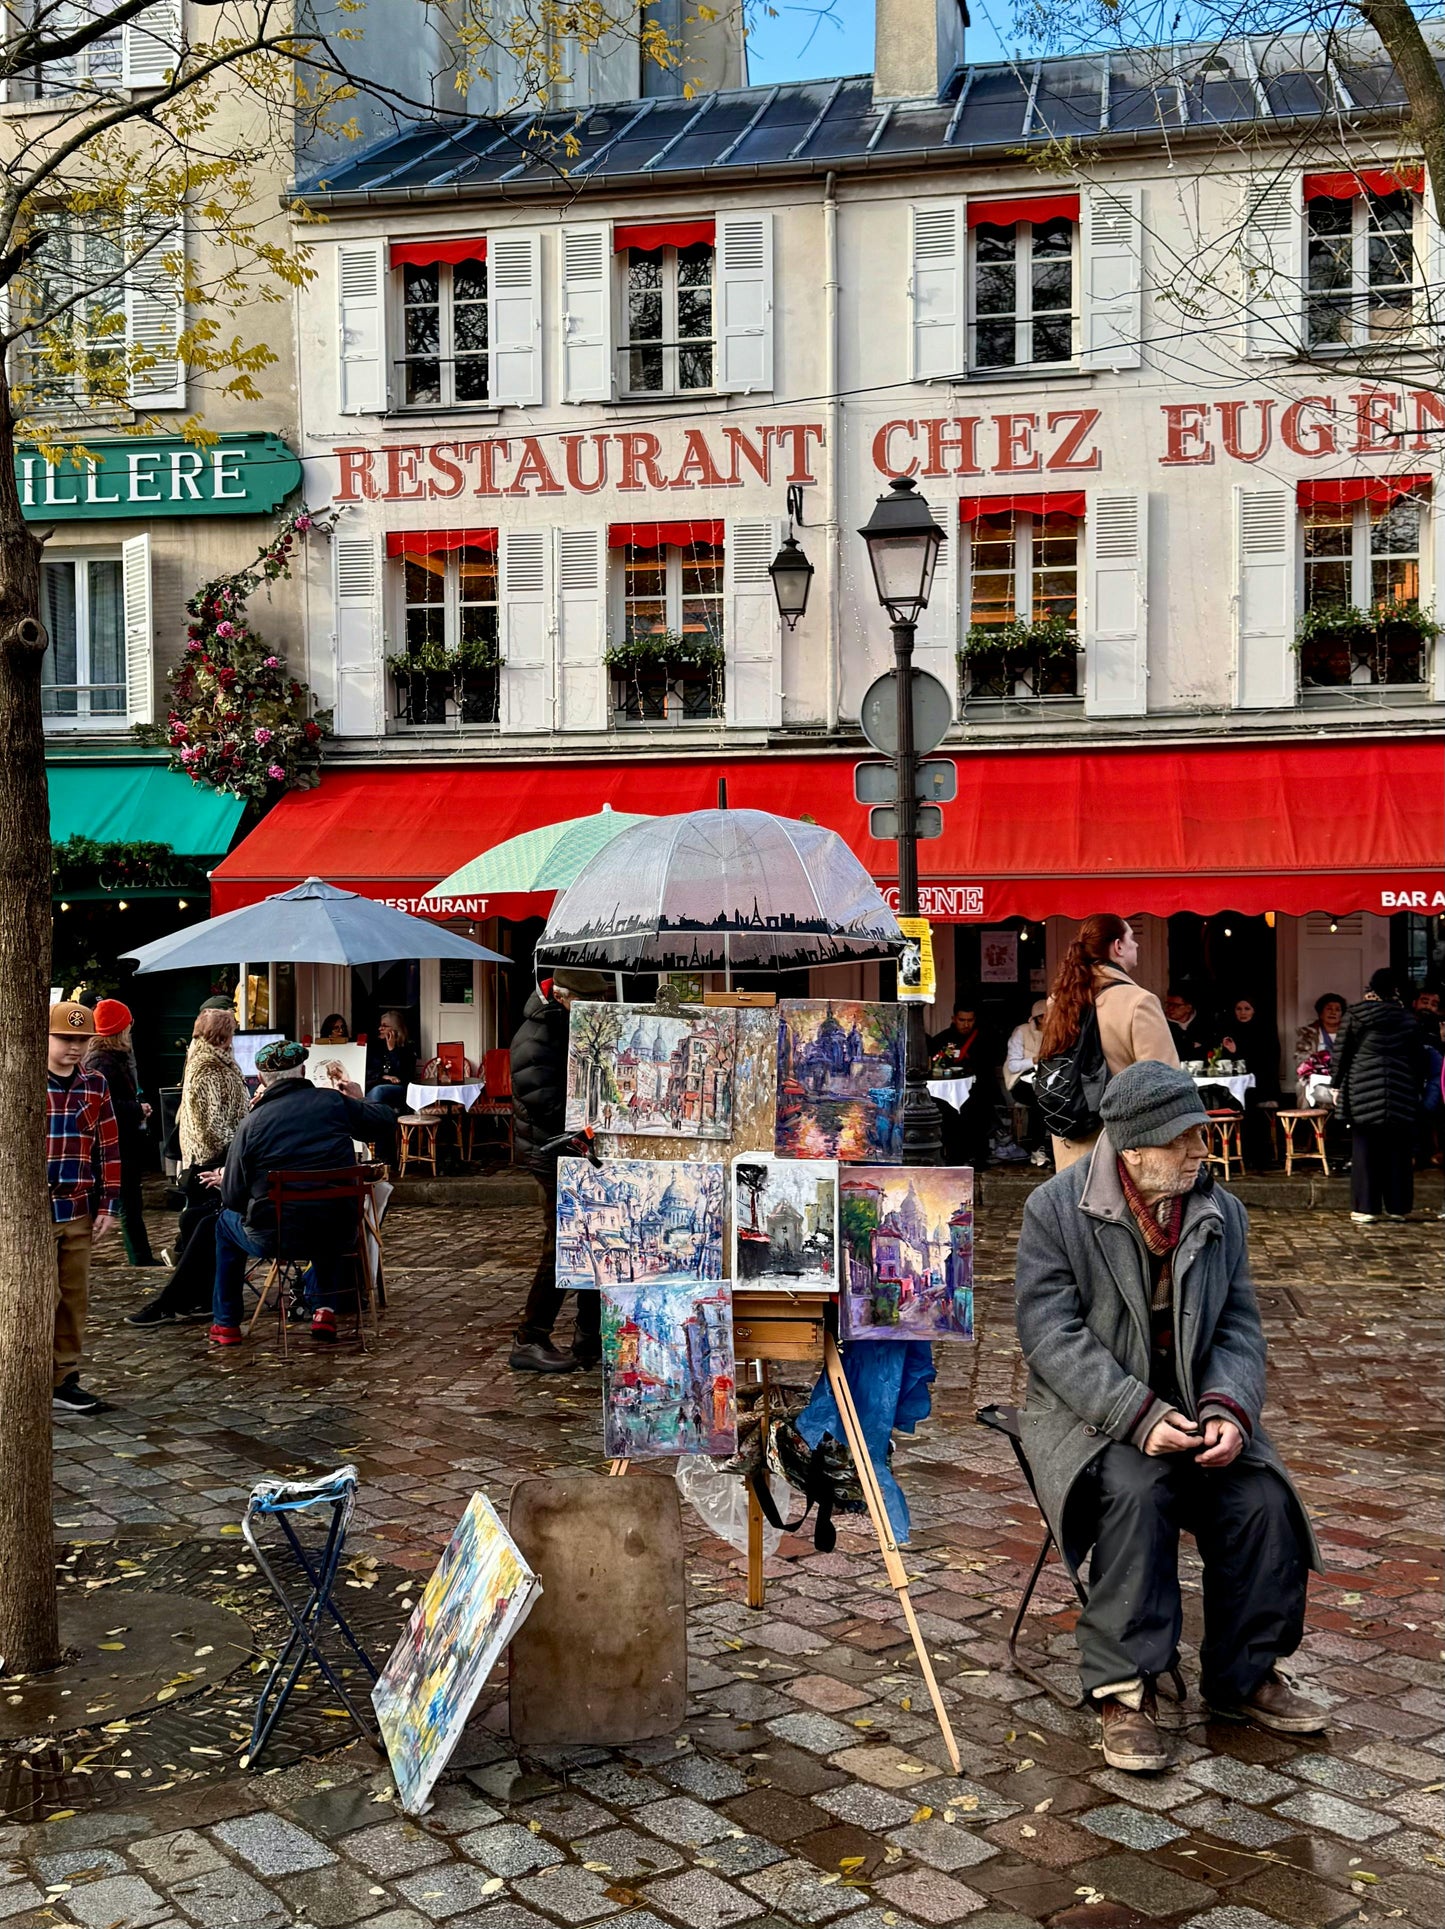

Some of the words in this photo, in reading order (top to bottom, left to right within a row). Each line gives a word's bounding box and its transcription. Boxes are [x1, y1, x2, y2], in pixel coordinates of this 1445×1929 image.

[332, 424, 825, 502] RESTAURANT
[872, 408, 1101, 478] CHEZ
[1381, 891, 1428, 907] BAR
